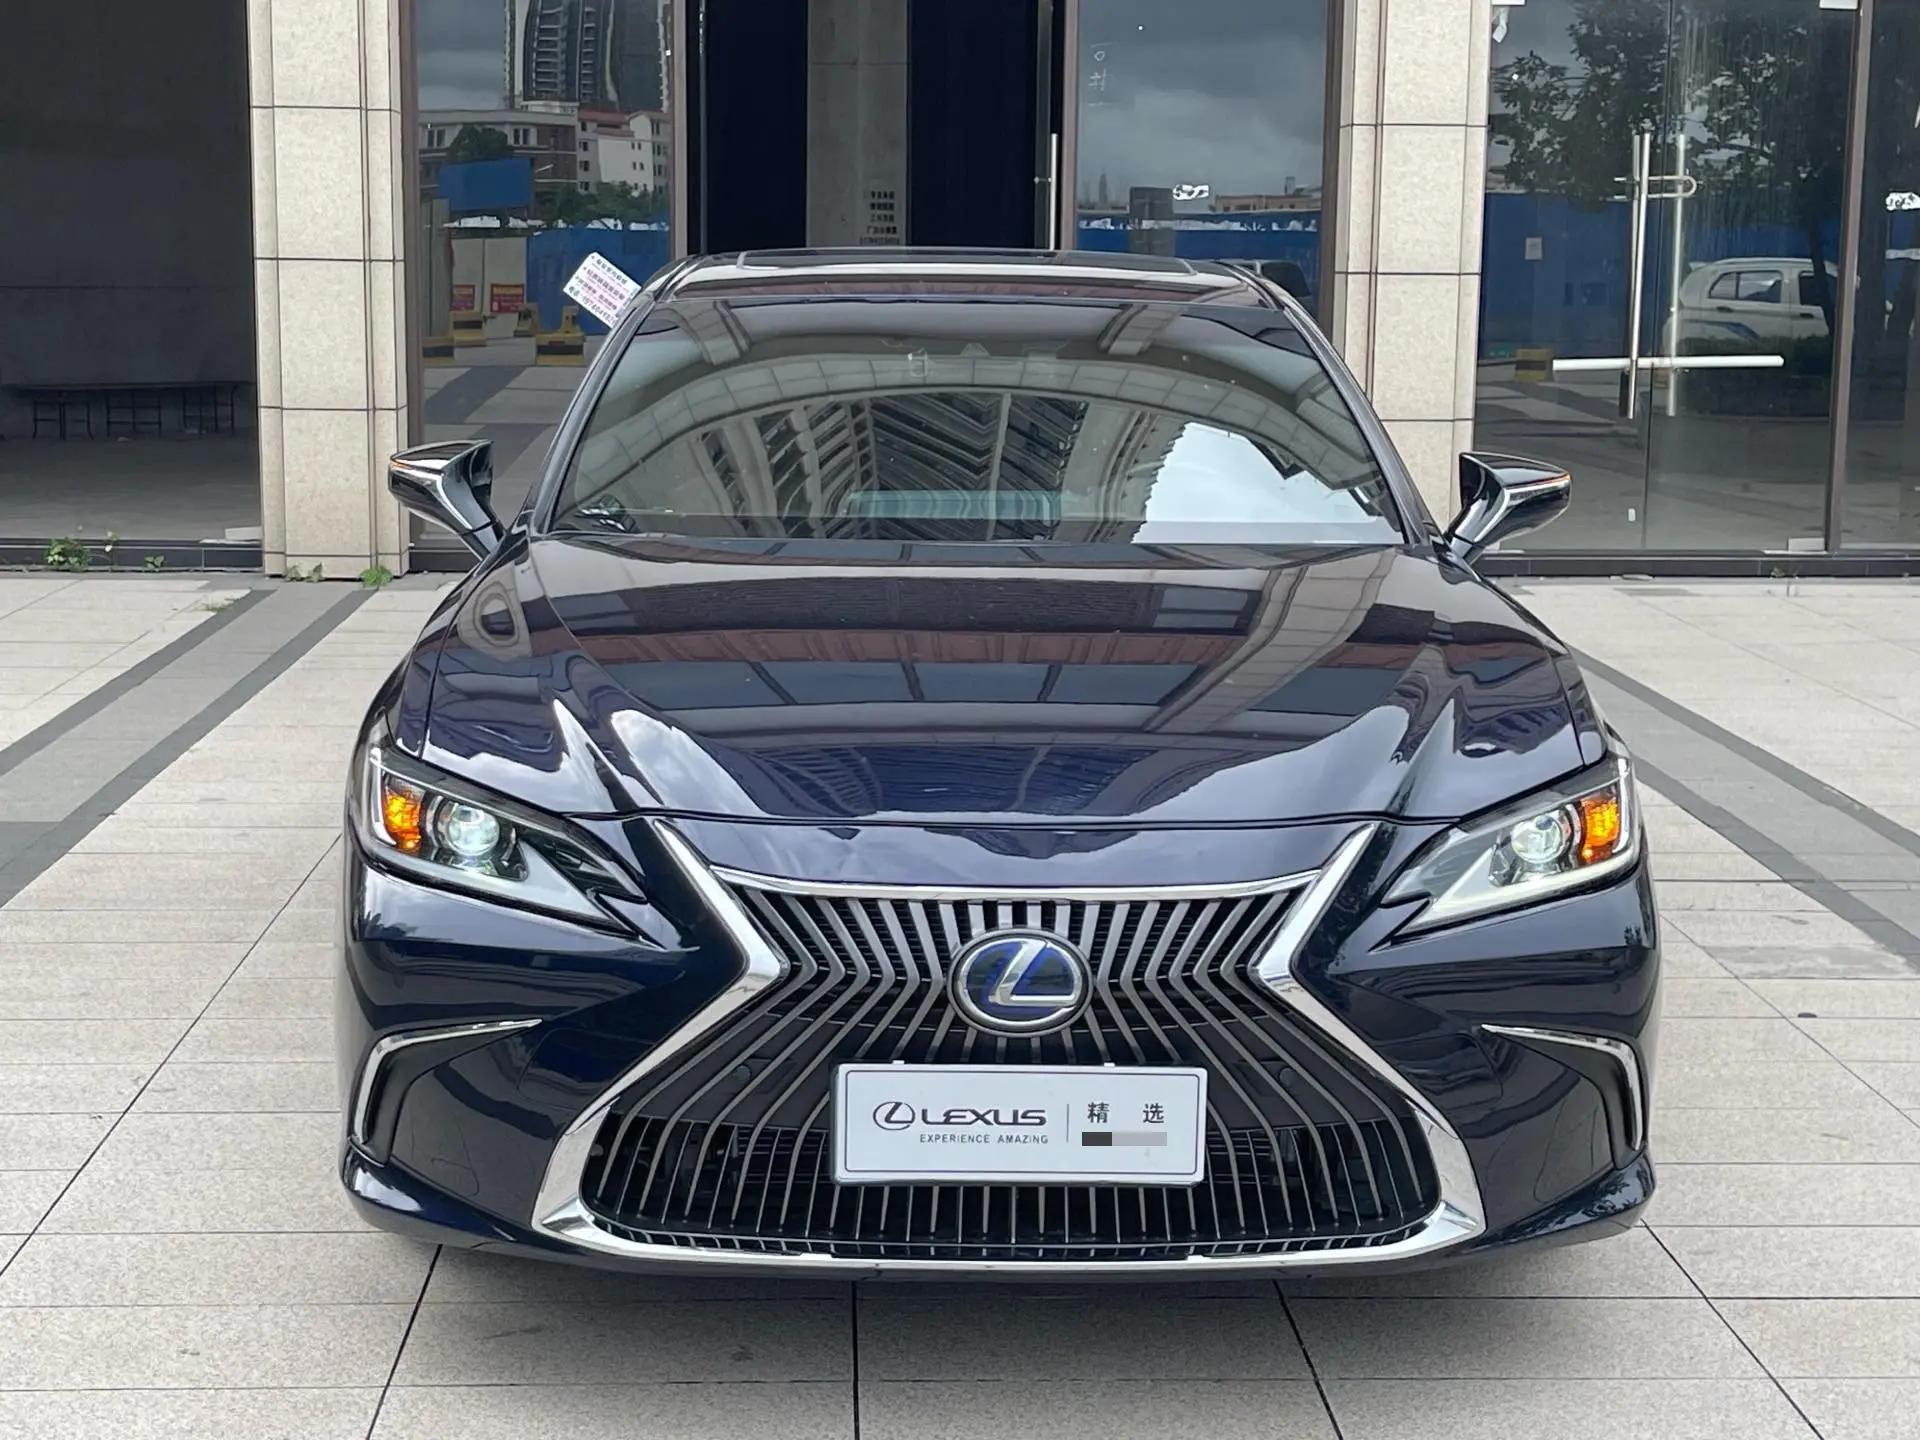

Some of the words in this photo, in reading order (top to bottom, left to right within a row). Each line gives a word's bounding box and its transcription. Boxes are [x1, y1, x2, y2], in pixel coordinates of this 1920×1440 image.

[922, 1108, 1047, 1126] LEXUS
[1087, 1102, 1165, 1124] 精选
[920, 1133, 991, 1144] EXPERIENCE
[997, 1134, 1049, 1144] AMAZING
